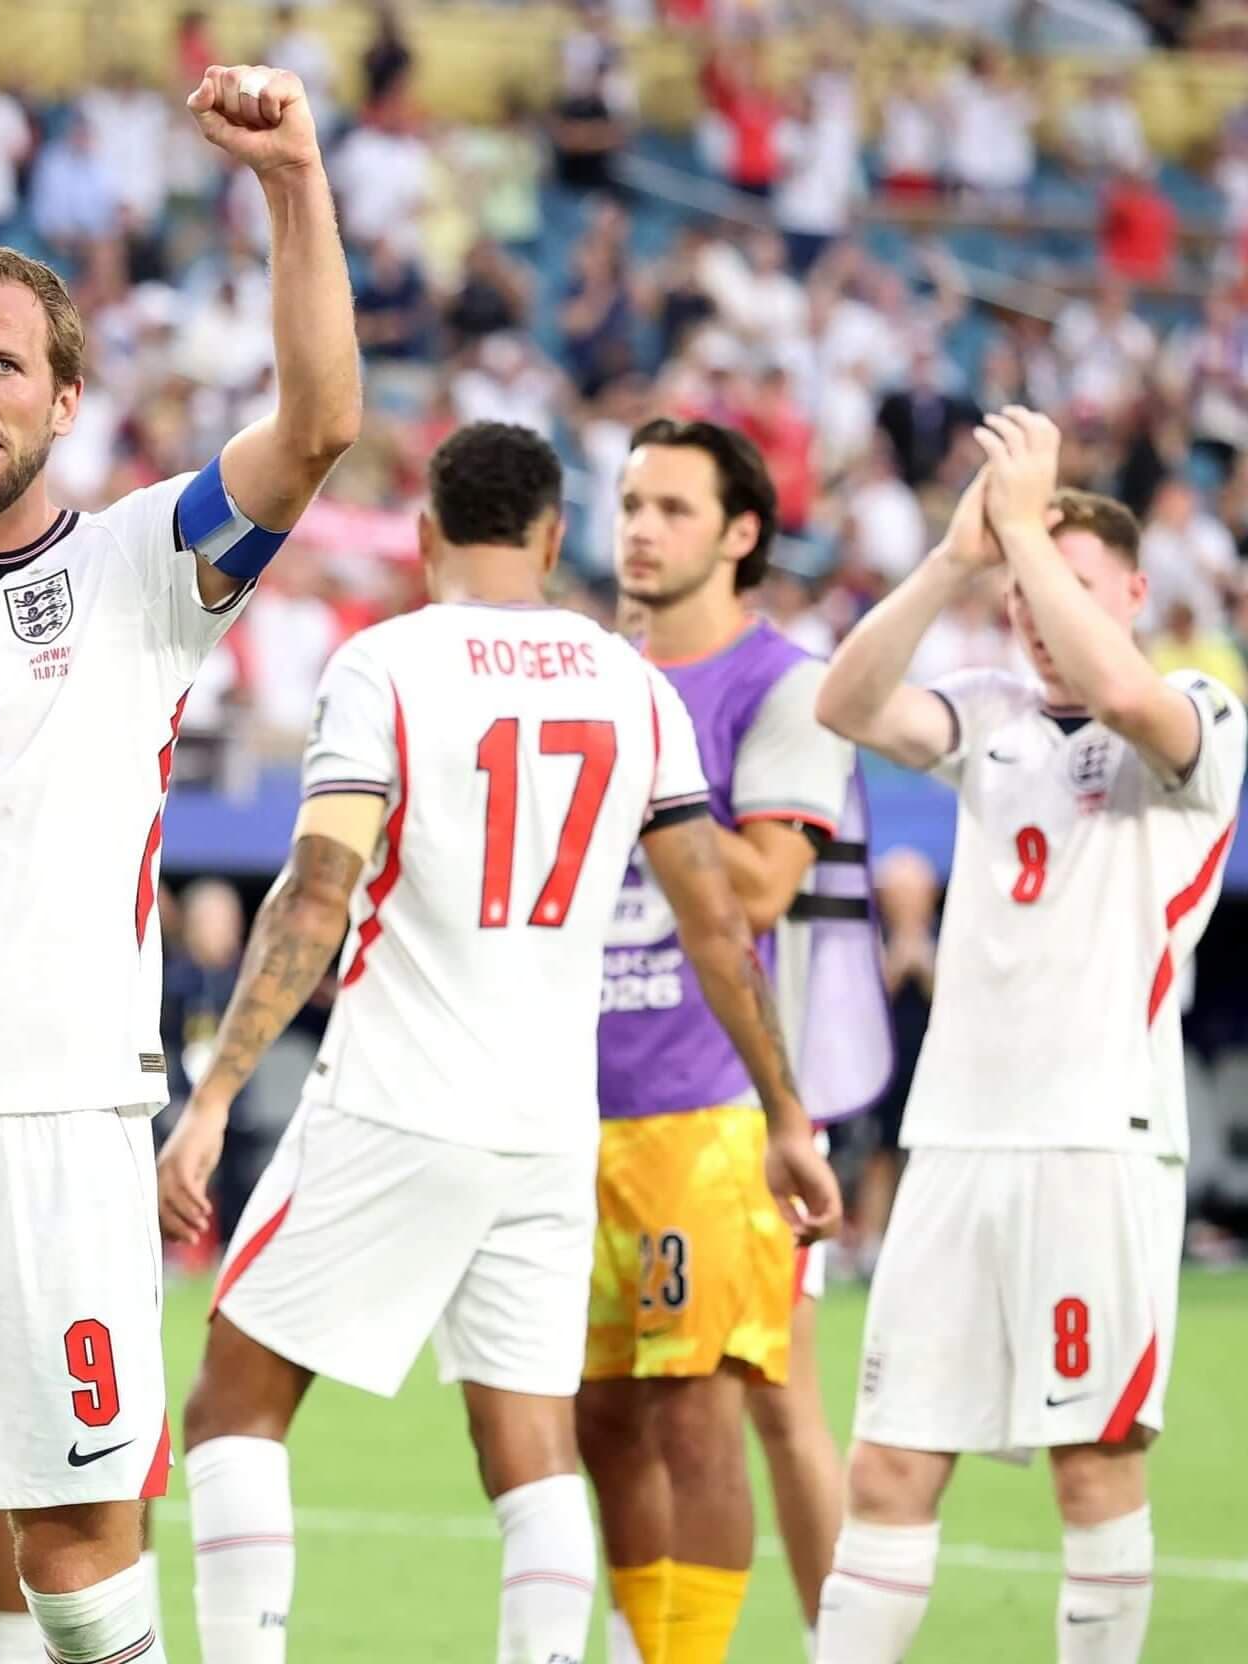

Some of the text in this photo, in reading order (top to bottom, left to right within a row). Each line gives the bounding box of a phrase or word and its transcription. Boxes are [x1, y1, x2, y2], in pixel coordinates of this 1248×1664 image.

[465, 638, 598, 681] ROGERS
[476, 717, 618, 928] 17
[1010, 824, 1050, 905] 8
[63, 1318, 121, 1428] 9
[1052, 1295, 1092, 1381] 8
